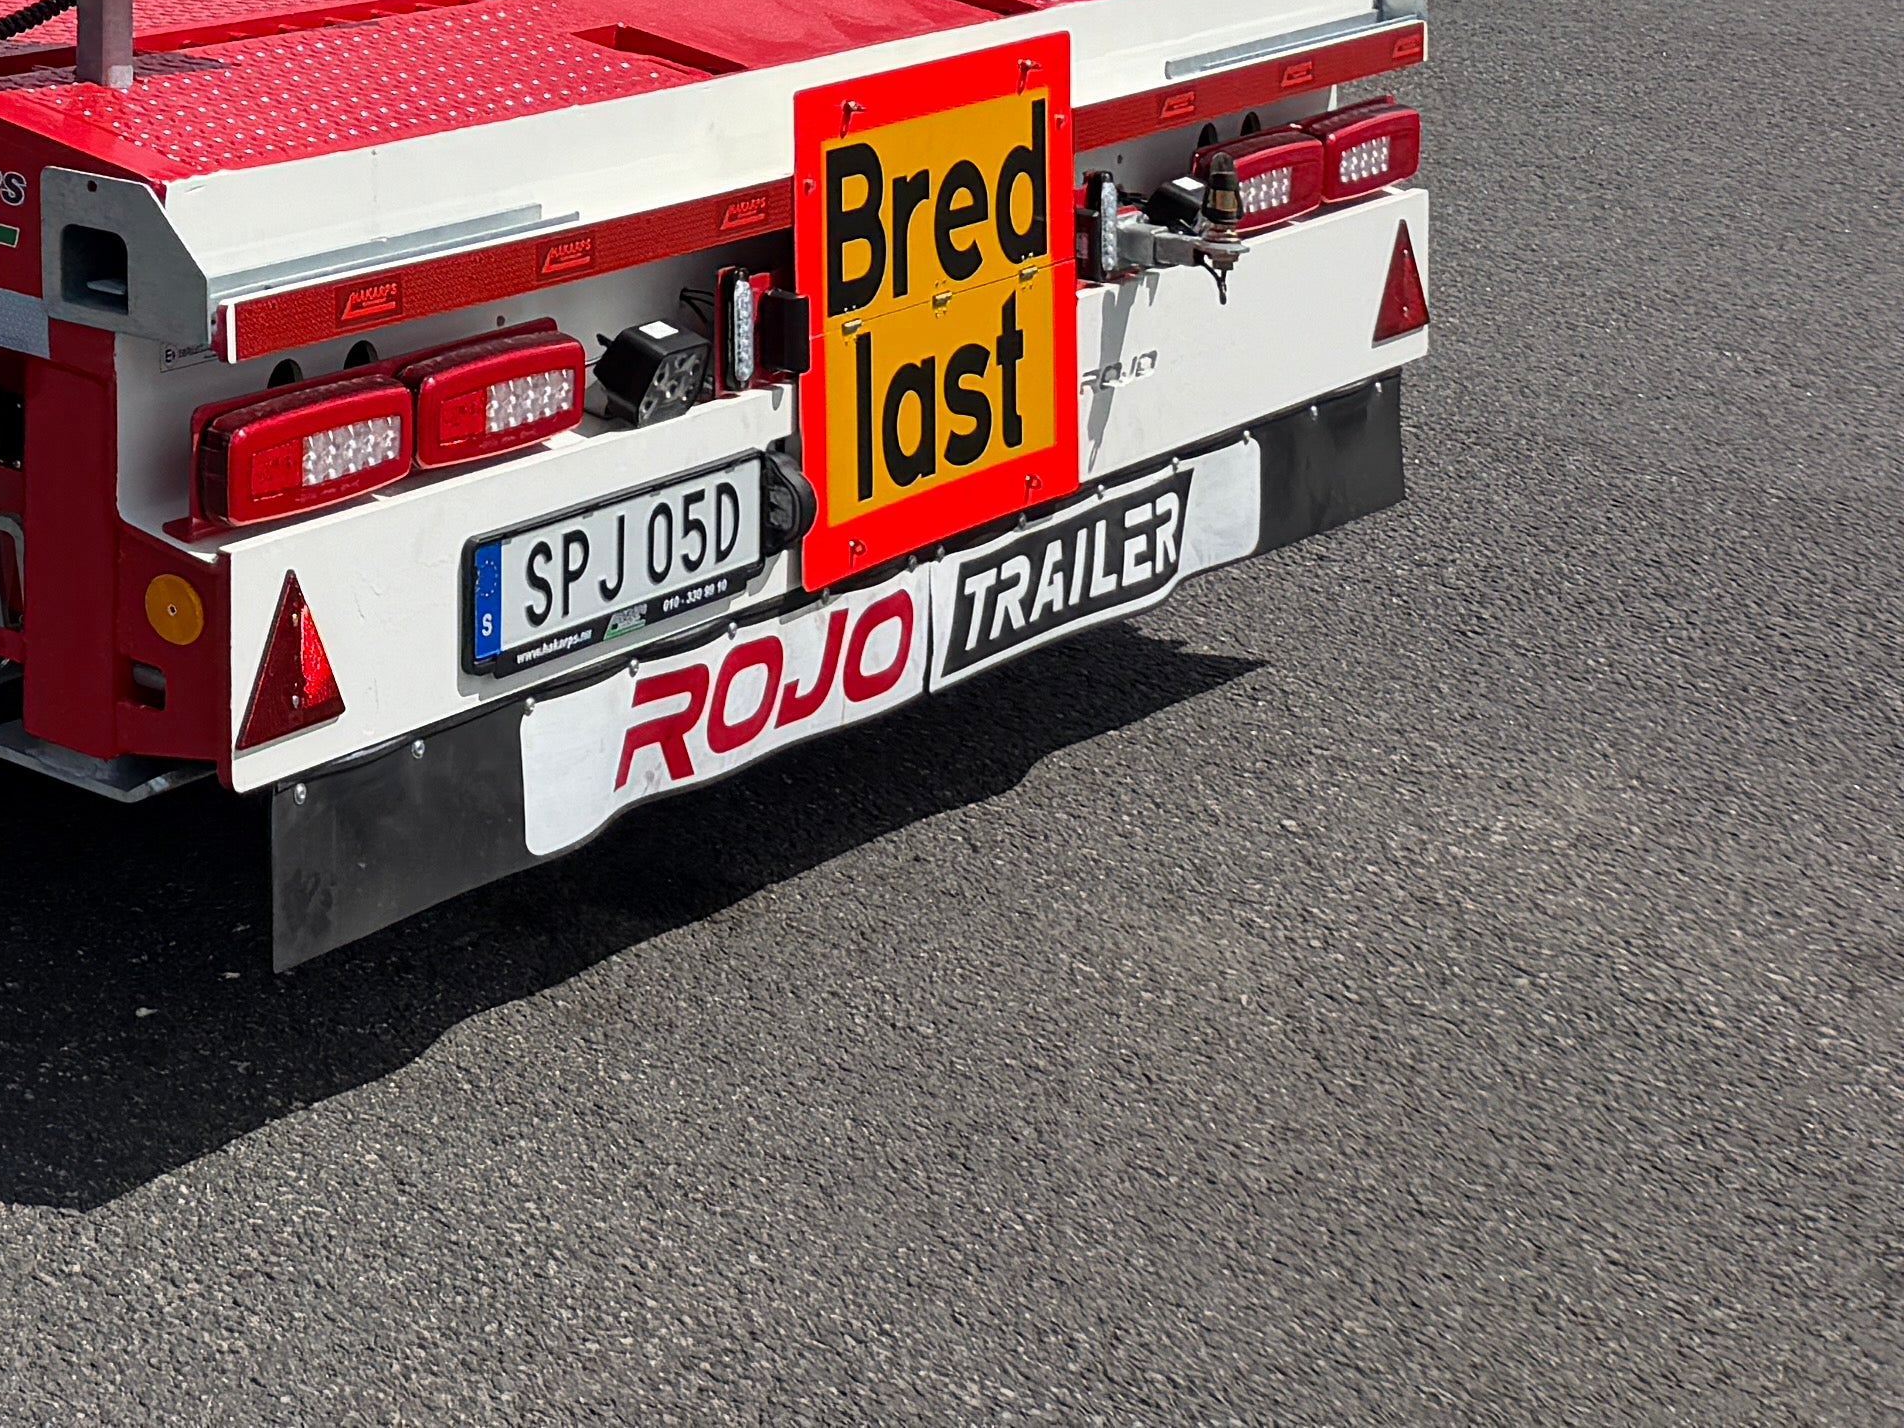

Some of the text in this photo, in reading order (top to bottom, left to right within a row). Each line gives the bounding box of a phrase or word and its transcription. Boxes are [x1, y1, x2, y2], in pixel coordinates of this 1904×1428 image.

[826, 98, 1048, 318] Bred
[855, 290, 1024, 502] last
[481, 613, 493, 637] S
[525, 482, 740, 627] SPJ 05D
[663, 595, 680, 612] 010
[963, 491, 1181, 651] TRAILER
[614, 589, 913, 792] ROJO
